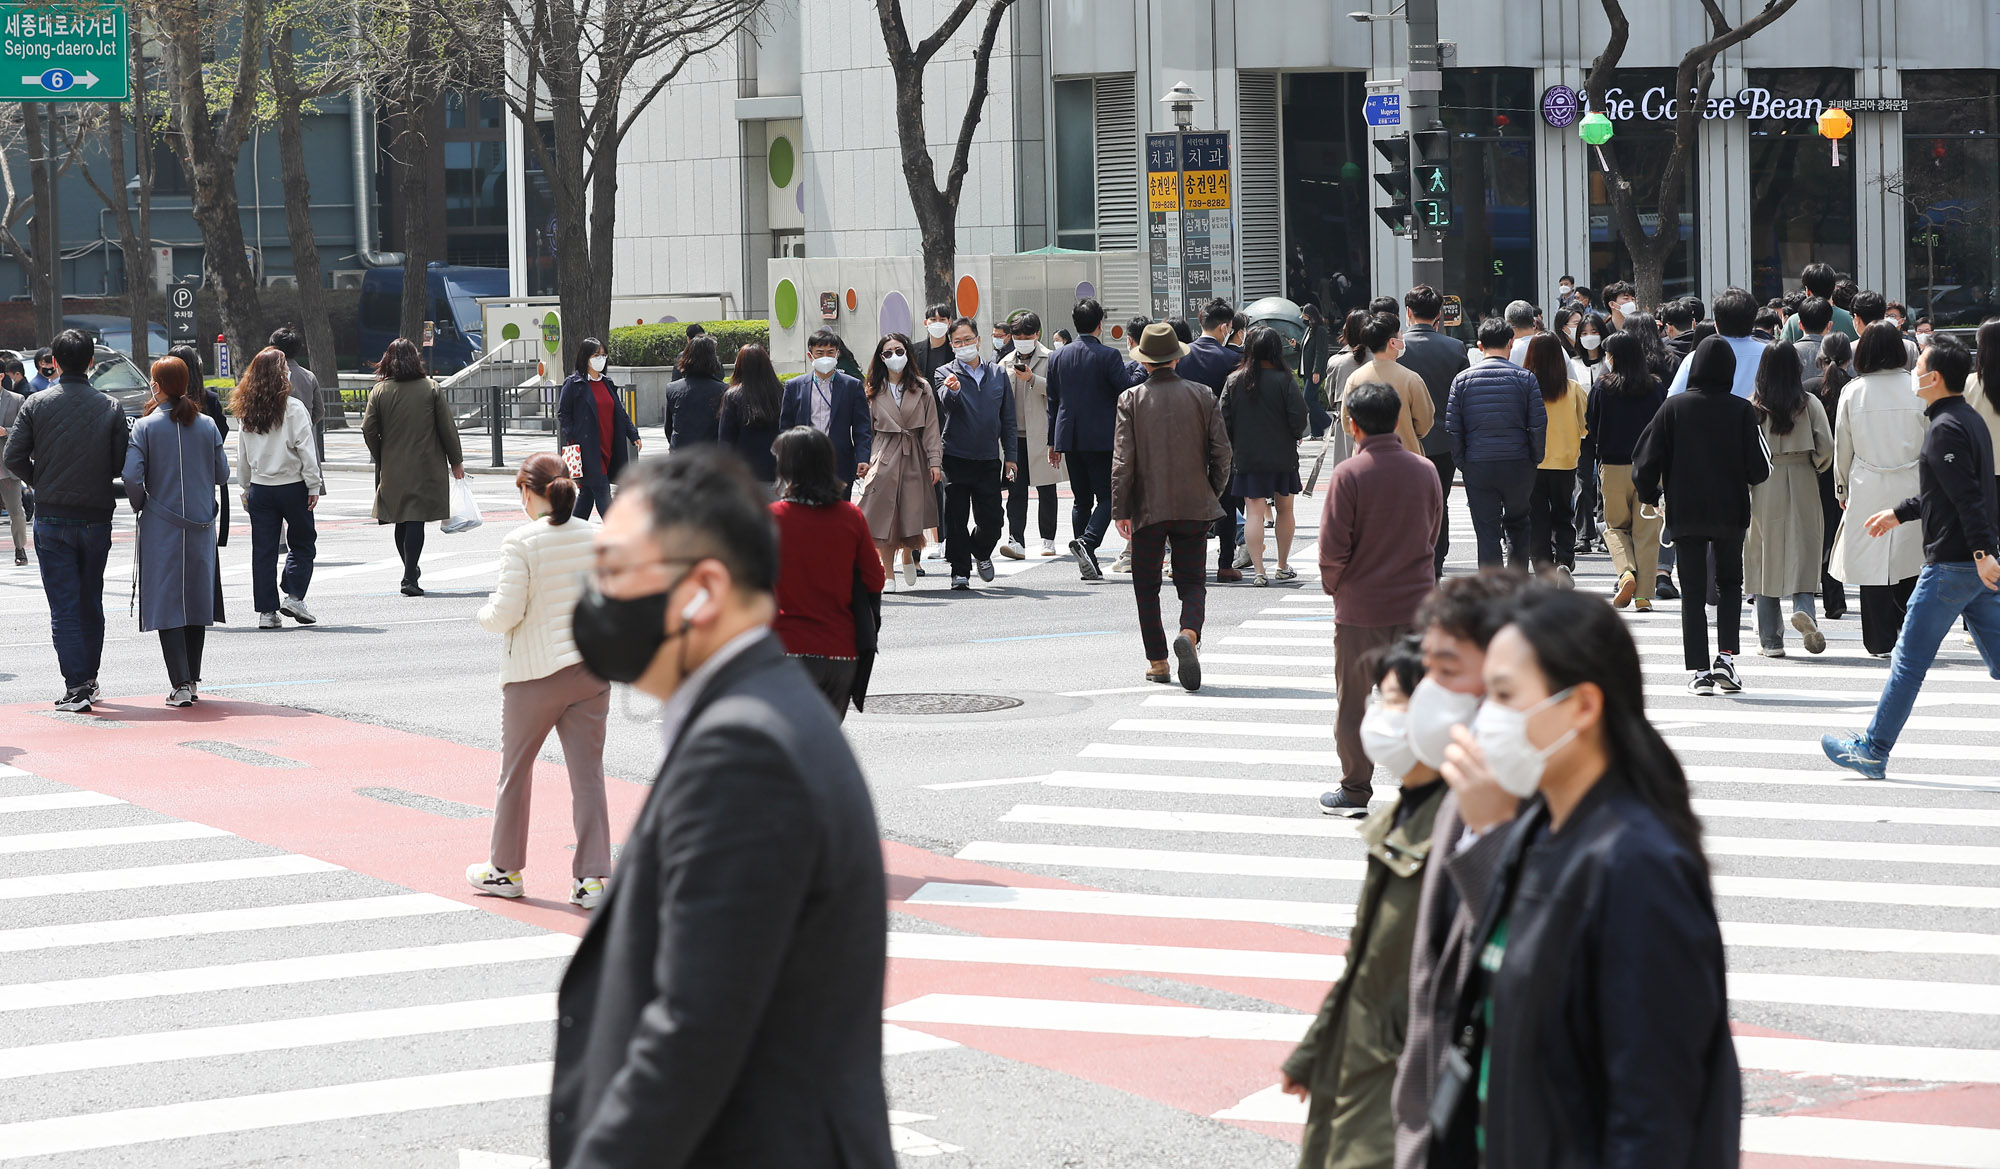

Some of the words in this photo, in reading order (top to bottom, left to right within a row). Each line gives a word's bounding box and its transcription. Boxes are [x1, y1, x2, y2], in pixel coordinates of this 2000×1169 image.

[5, 13, 117, 38] 세종대로사거리
[5, 39, 94, 59] Sejong-daero
[96, 39, 117, 56] Jct
[51, 72, 64, 88] 6
[1739, 87, 1823, 124] Bean
[1828, 99, 1876, 111] 커피빈코리아
[1877, 99, 1908, 111] 광화문점
[1150, 175, 1177, 196] 송전일식
[1186, 174, 1227, 195] 송전일식
[1188, 199, 1225, 207] 739-8282
[1186, 218, 1210, 232] 삼계탕
[1187, 245, 1210, 260] 두부촌
[1188, 270, 1211, 285] 안동국시
